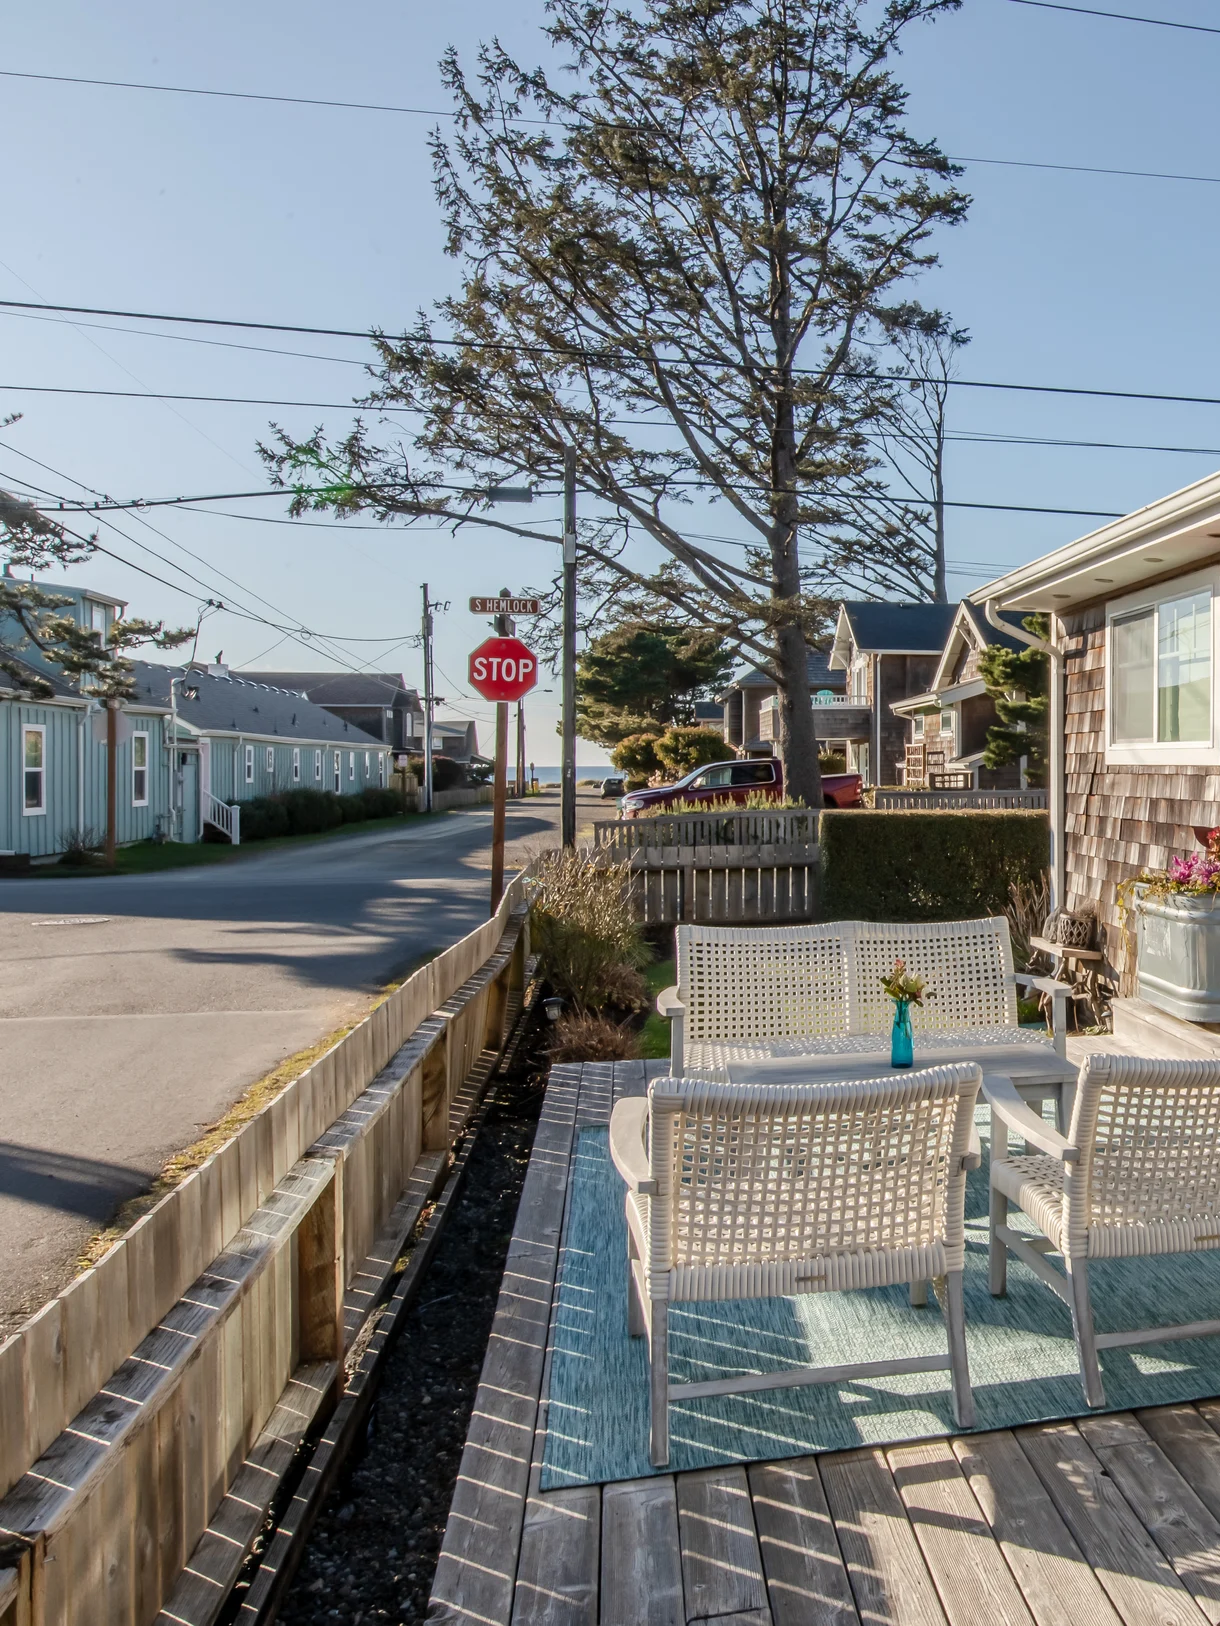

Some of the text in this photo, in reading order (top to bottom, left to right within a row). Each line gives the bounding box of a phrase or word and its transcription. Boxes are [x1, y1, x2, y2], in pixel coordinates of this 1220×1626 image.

[475, 599, 533, 613] S HEMLOCK
[473, 657, 534, 683] STOP
